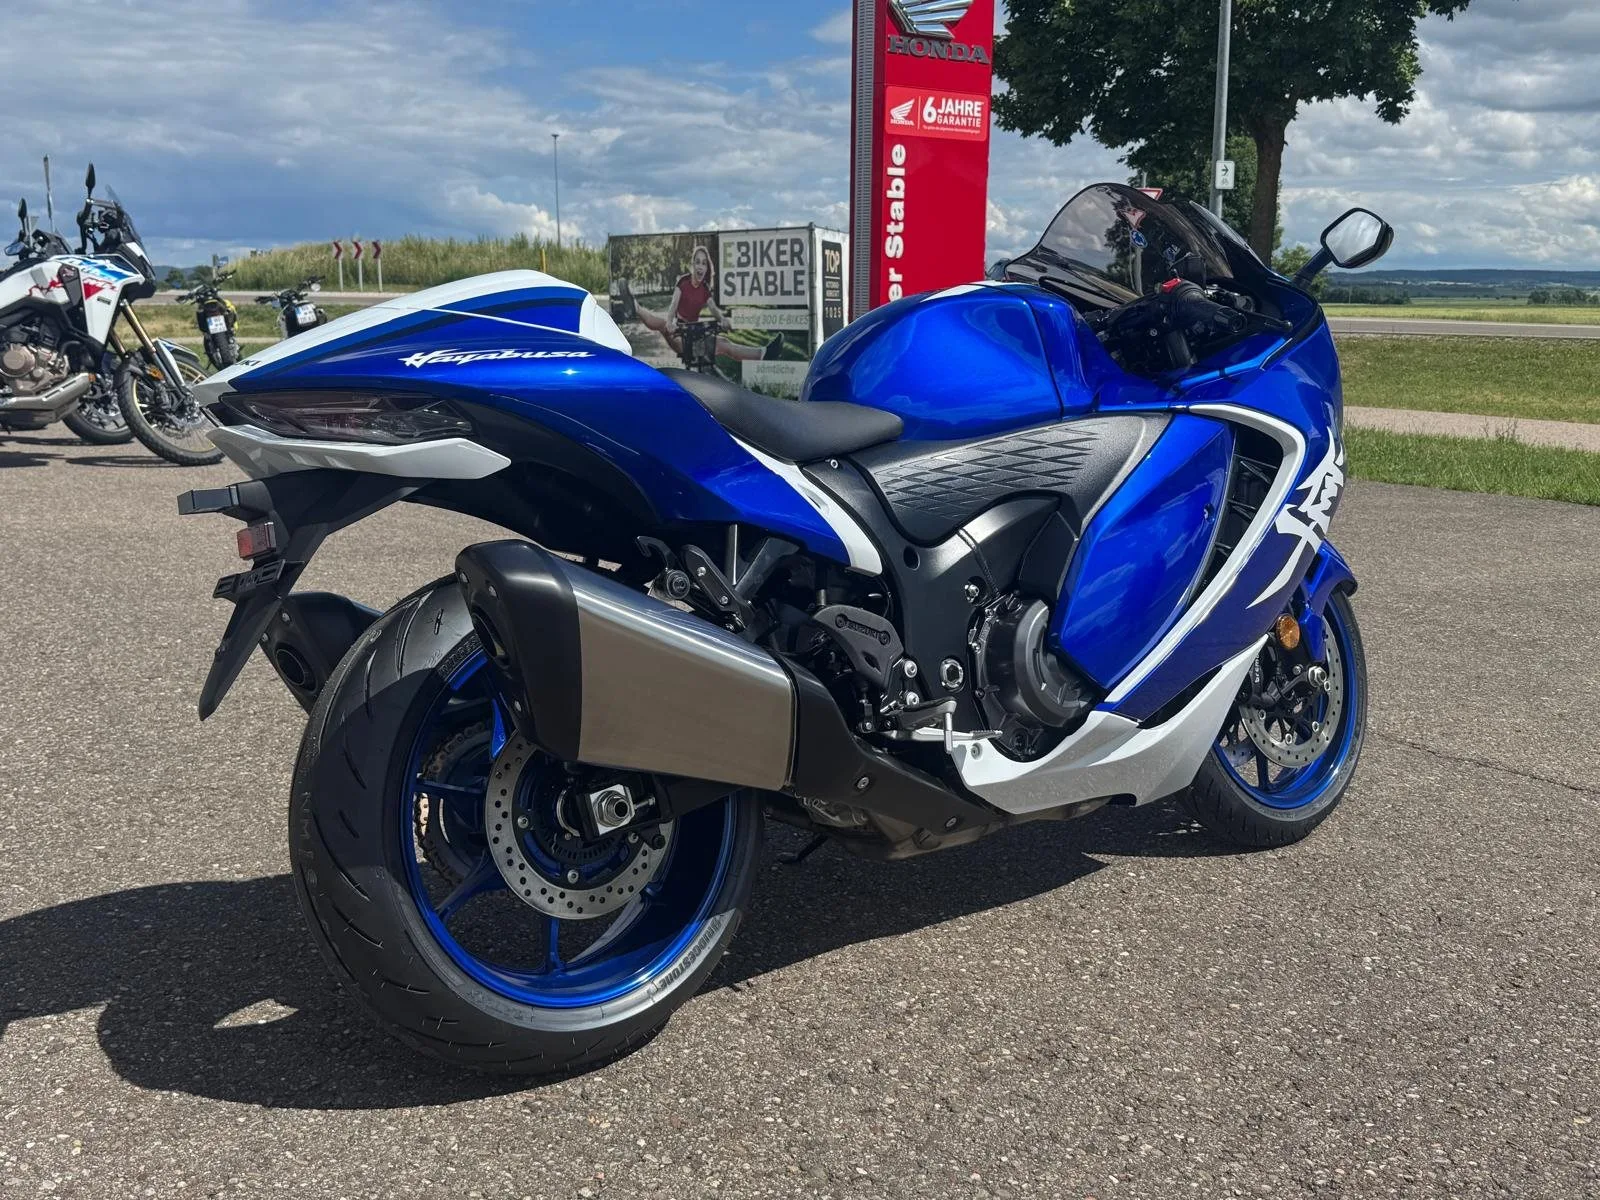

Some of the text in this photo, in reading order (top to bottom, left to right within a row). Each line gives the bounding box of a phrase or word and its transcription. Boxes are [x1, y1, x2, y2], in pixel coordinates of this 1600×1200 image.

[887, 34, 990, 65] HONDA
[890, 118, 915, 126] HONDA
[922, 96, 937, 124] 6
[937, 114, 982, 128] GARANTIE
[885, 144, 906, 259] Stable
[825, 249, 840, 274] TOP
[723, 270, 806, 297] STABLE
[398, 348, 597, 369] Hayabusa
